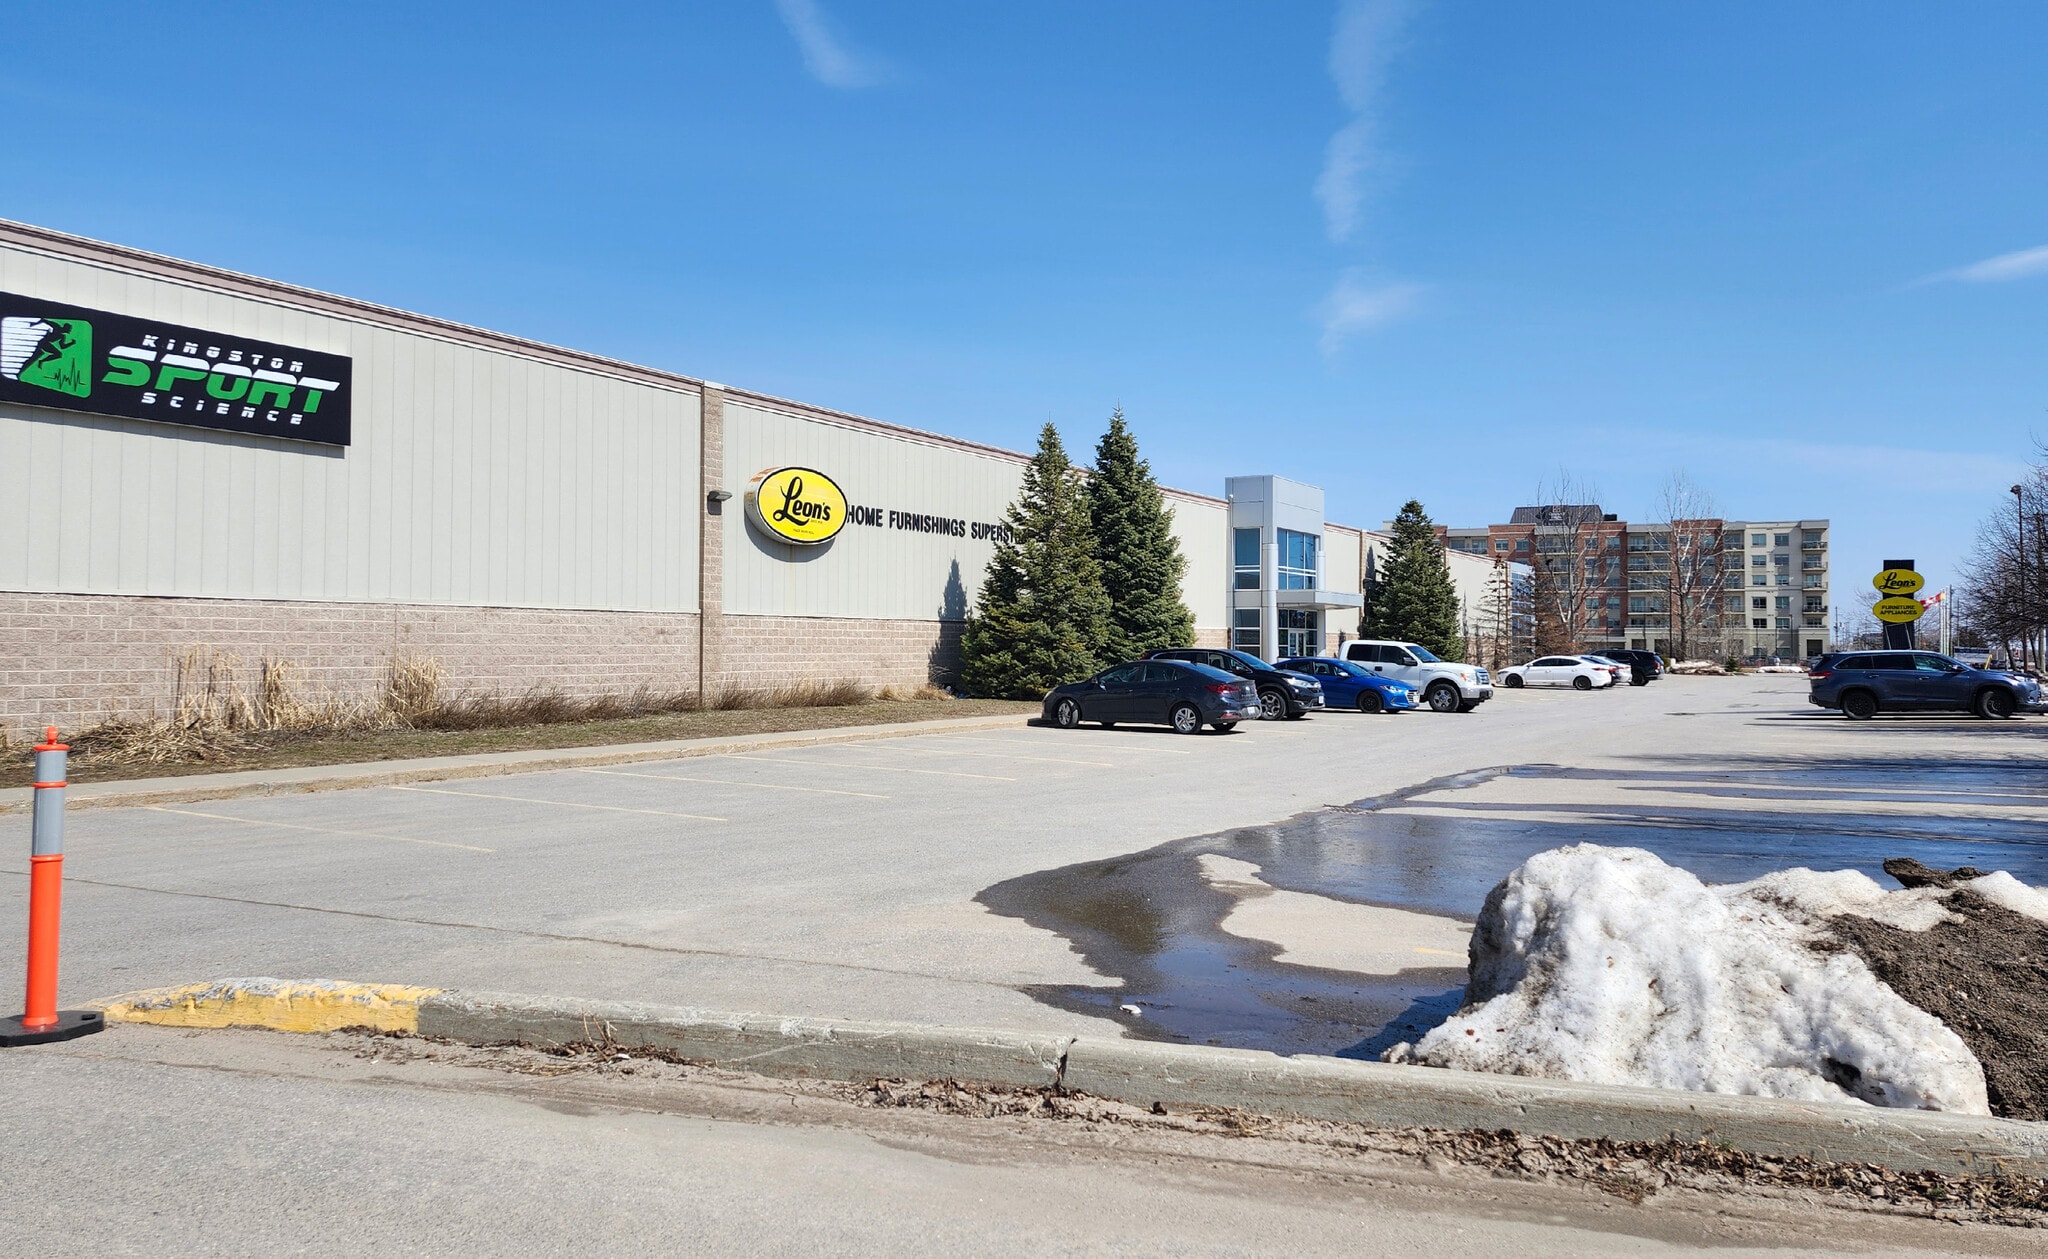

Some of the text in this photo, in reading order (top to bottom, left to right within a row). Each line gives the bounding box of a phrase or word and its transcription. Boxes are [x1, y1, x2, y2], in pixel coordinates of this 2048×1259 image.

[142, 334, 304, 373] KINGSTON
[102, 345, 340, 413] SPORT
[141, 392, 303, 425] SCIENCE
[773, 476, 831, 526] Leon's
[846, 504, 1015, 545] HOME FURNISHINGS SUPERST
[1879, 572, 1916, 590] Leon's
